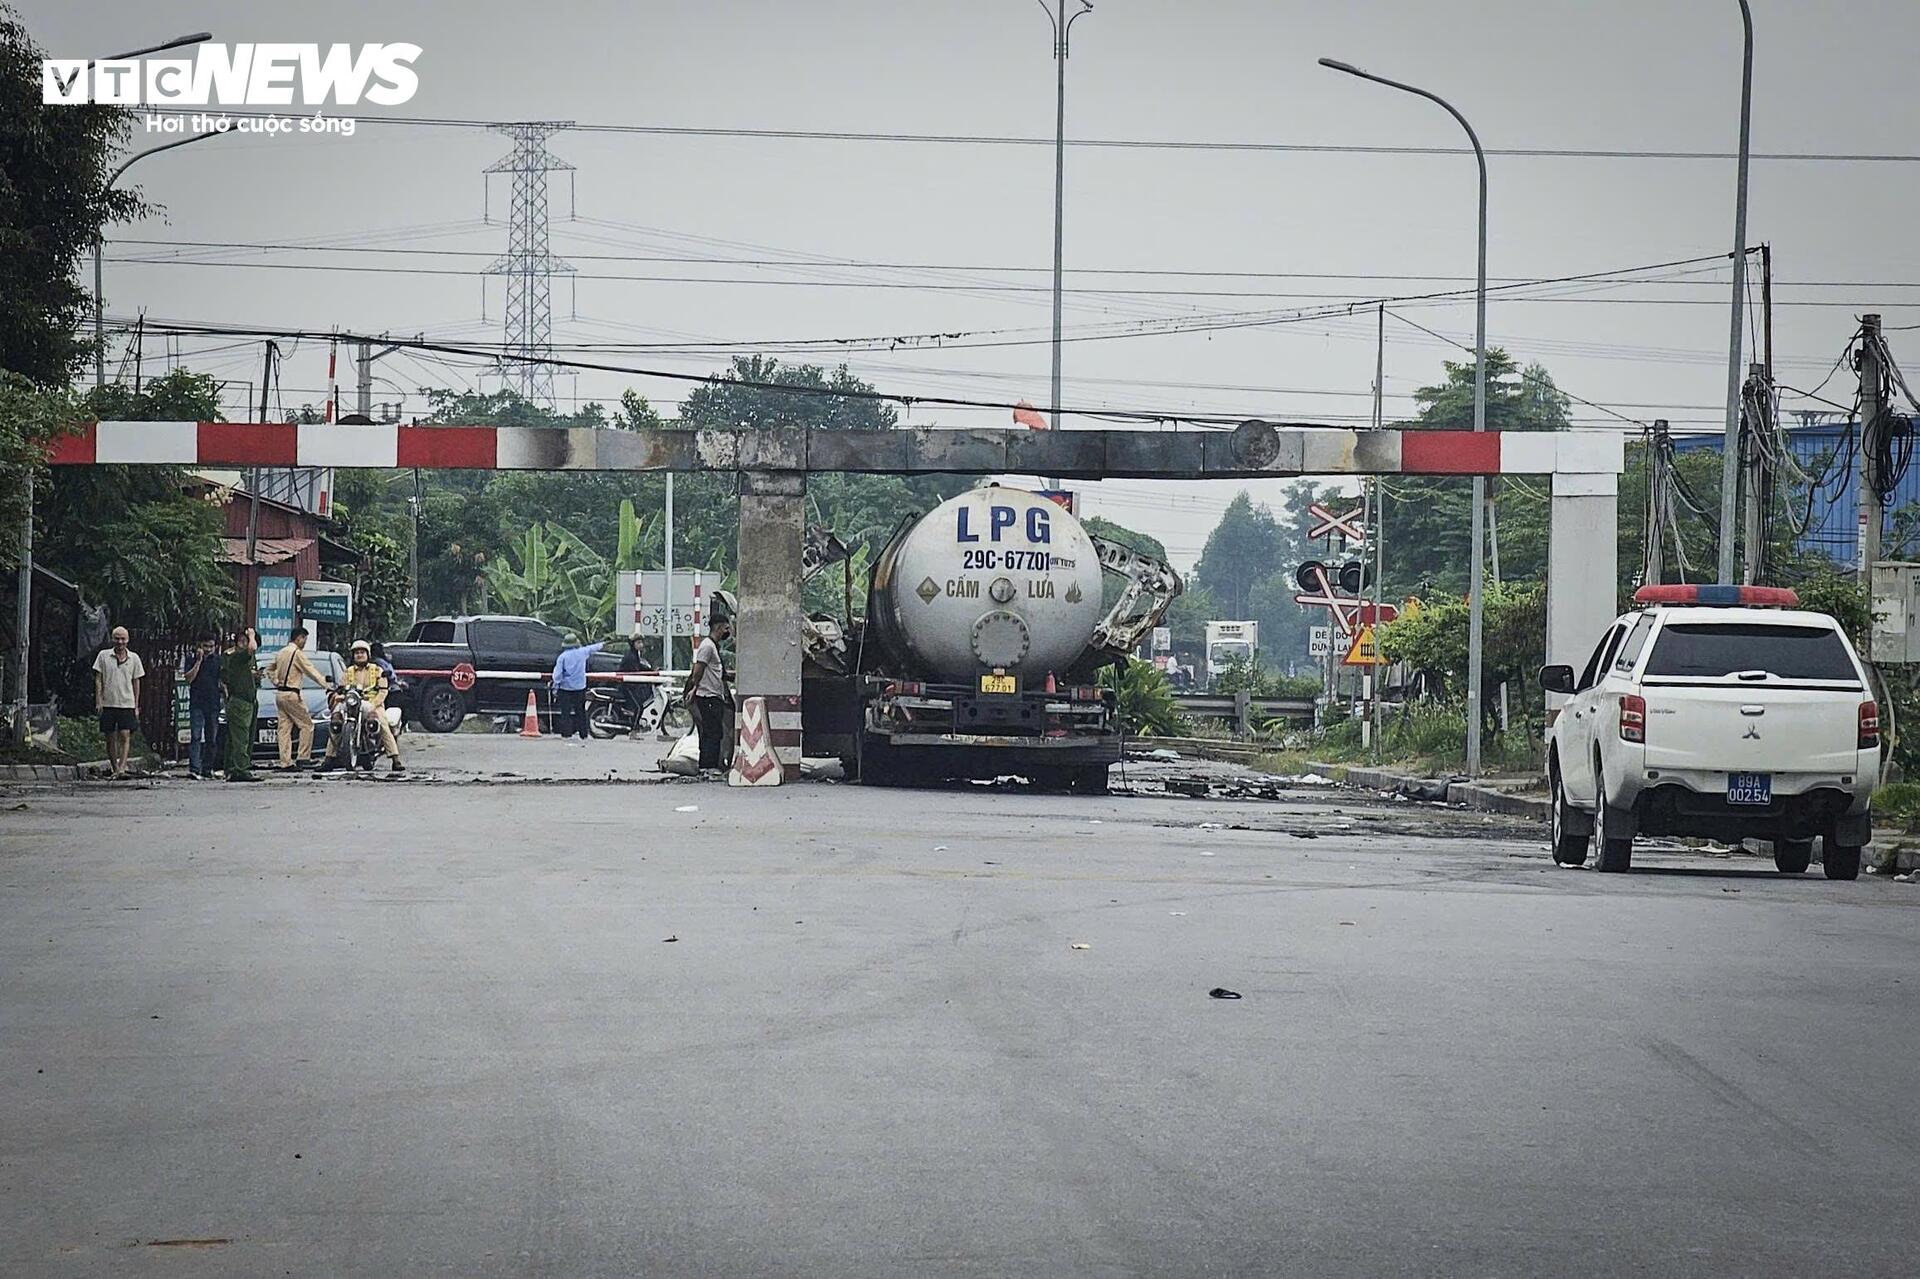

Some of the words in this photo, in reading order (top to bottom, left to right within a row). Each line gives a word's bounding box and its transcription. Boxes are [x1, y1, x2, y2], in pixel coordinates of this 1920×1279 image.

[946, 573, 980, 599] CẤM
[1027, 573, 1055, 599] LỬA
[1737, 776, 1761, 788] 89A
